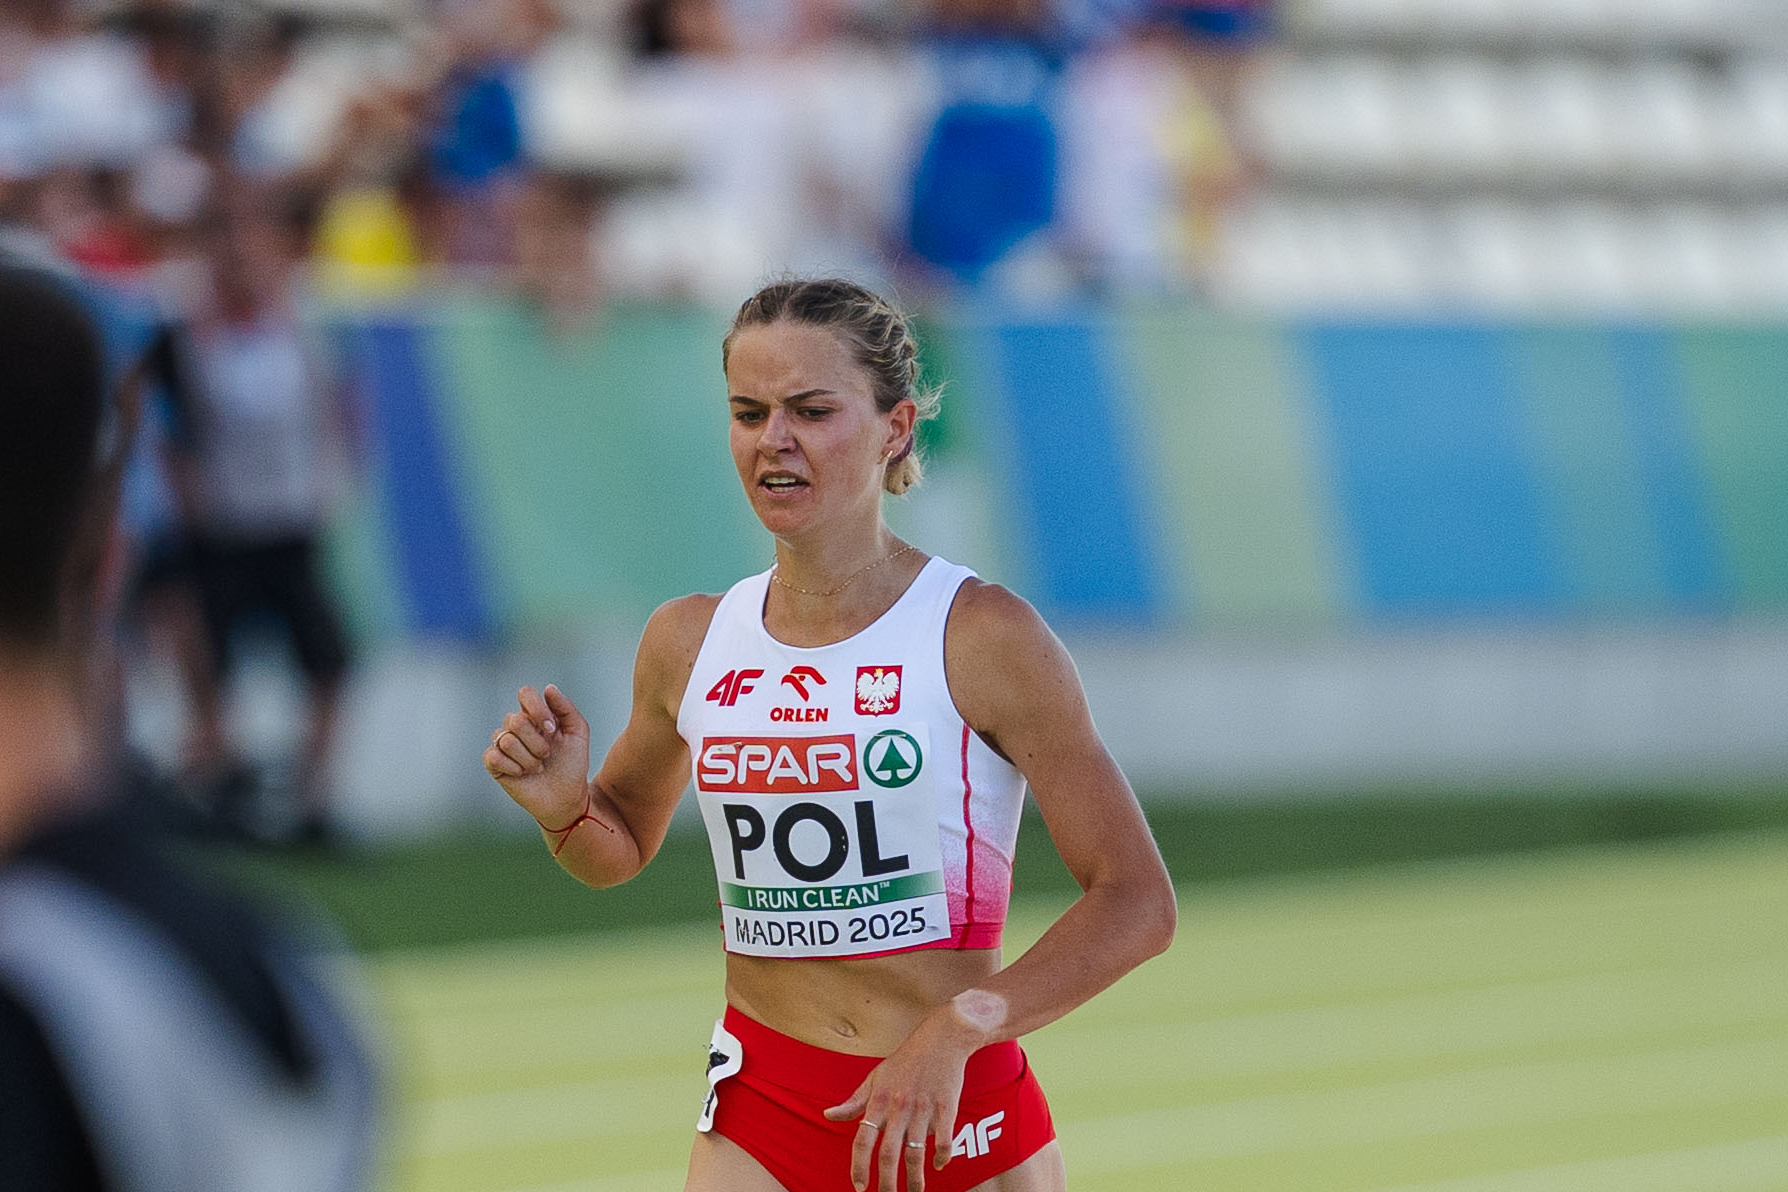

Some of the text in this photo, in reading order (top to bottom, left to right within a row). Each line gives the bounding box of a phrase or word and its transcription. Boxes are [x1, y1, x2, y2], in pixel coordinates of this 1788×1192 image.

[705, 668, 765, 707] 4F
[769, 707, 829, 723] ORLEN
[700, 742, 854, 786] SPAR
[722, 800, 909, 882] POL
[748, 889, 754, 908] I
[755, 890, 797, 909] RUN
[735, 906, 927, 947] MADRID 2025
[951, 1110, 1005, 1159] 4F
